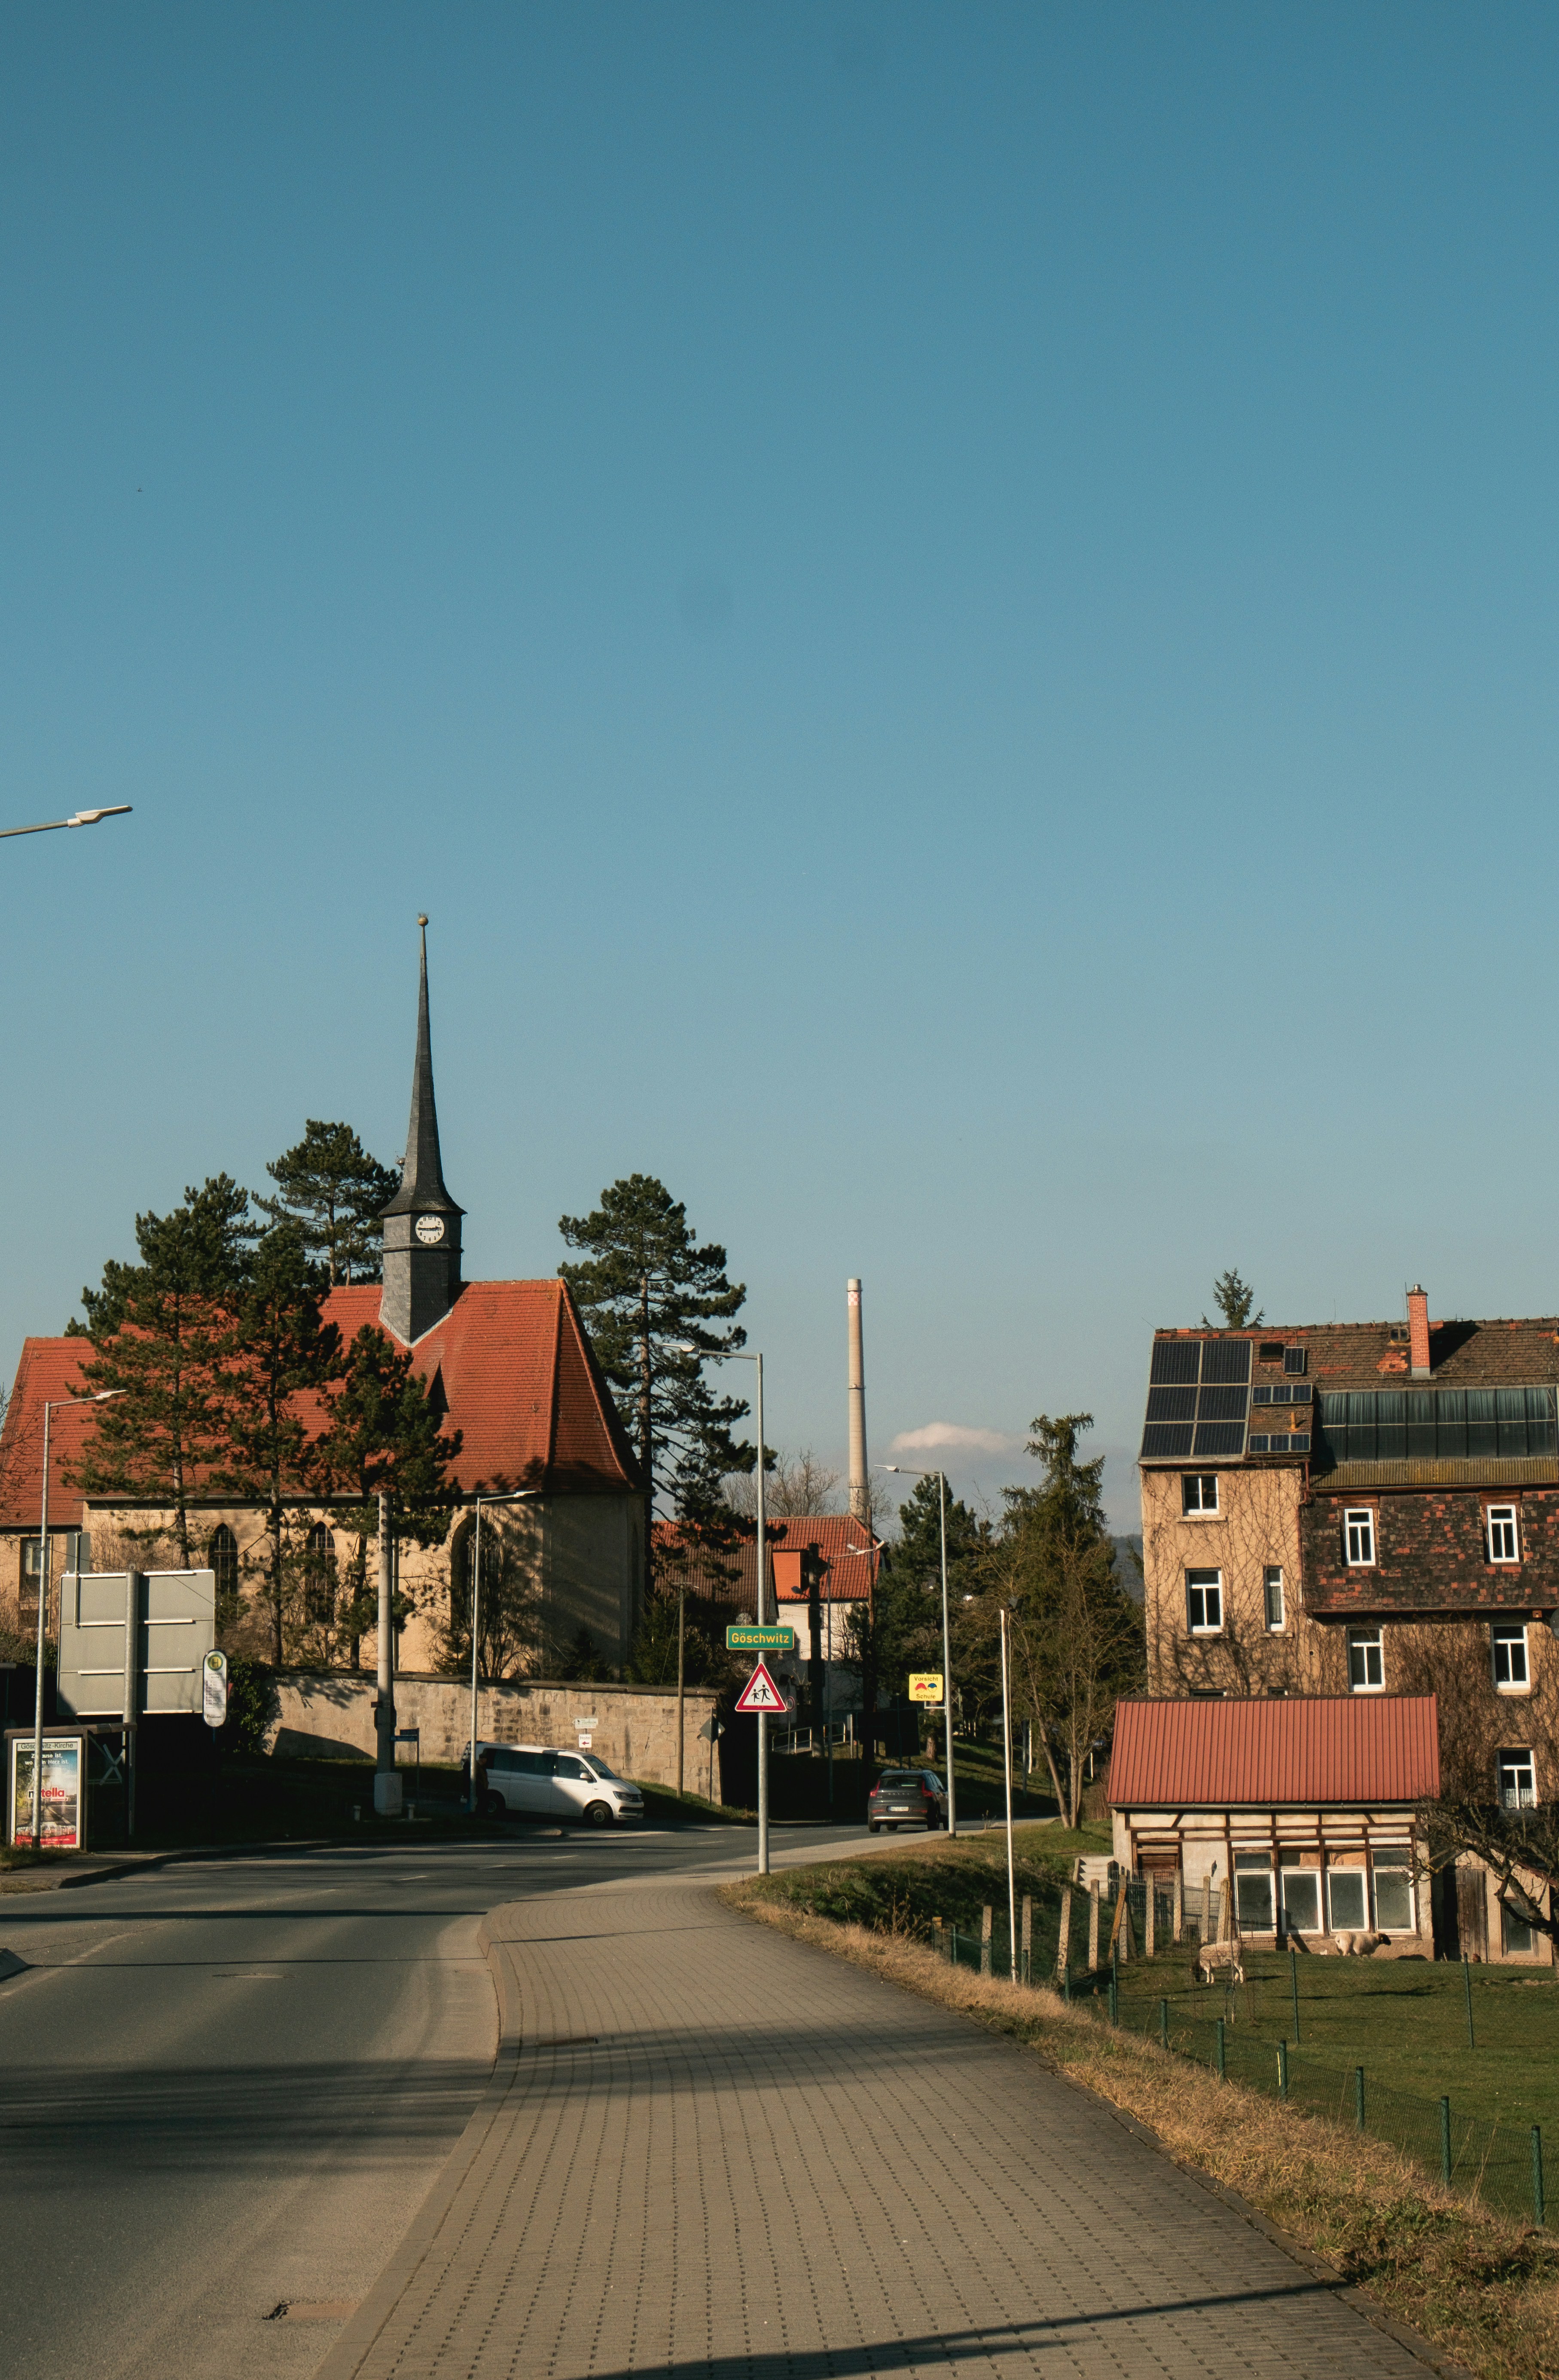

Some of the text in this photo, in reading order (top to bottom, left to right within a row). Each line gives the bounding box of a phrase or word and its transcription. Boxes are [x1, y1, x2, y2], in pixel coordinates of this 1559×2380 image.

[731, 1632, 789, 1643] Göschwitz
[212, 1658, 219, 1668] H
[28, 1787, 64, 1798] ntella
